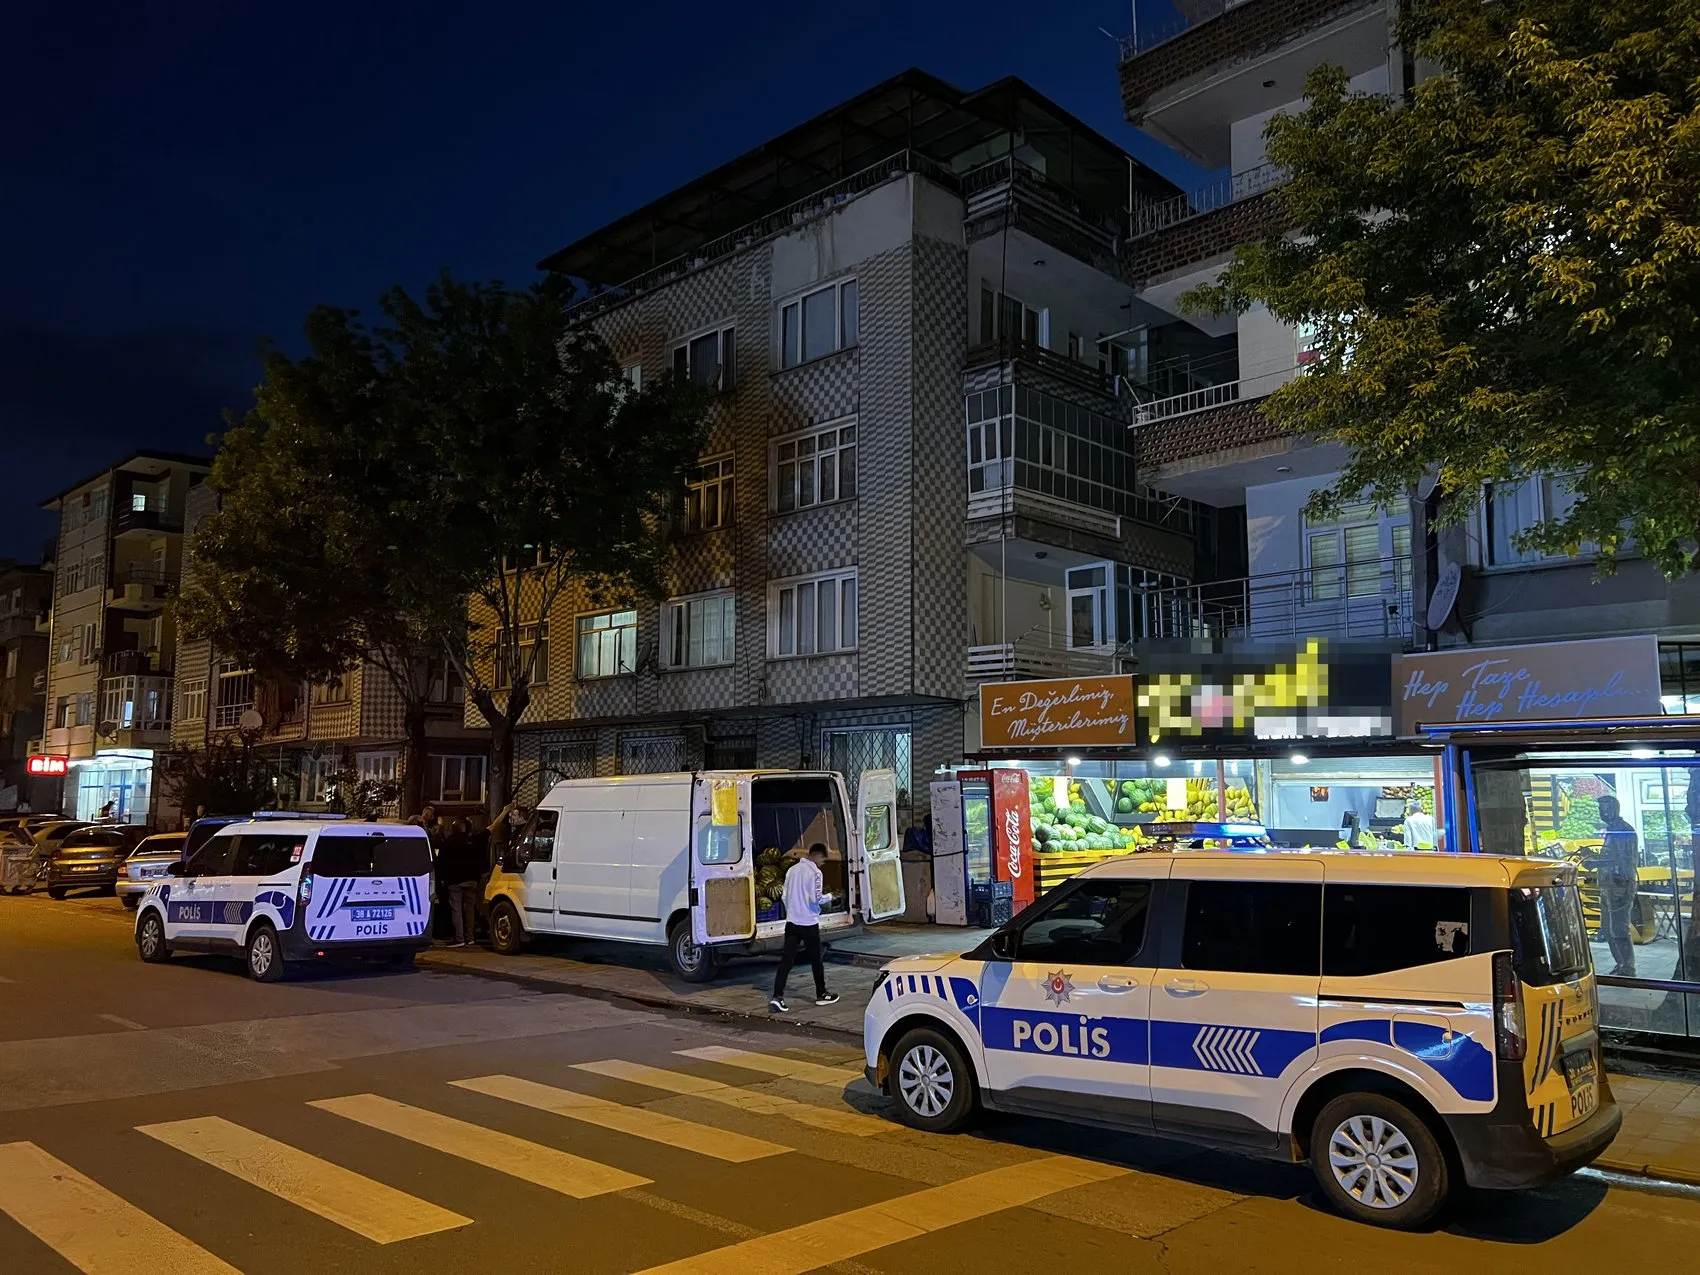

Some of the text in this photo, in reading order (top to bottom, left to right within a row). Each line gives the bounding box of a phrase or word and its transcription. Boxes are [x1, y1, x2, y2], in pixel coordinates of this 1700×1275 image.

[1404, 659, 1530, 707] Hep Taze
[991, 684, 1114, 722] En Değerlimiz,
[1456, 691, 1504, 720] Hep
[1007, 708, 1129, 741] Müşterilerimiz
[31, 757, 64, 772] BİM
[178, 904, 201, 920] POLİS
[356, 922, 388, 935] POLİS
[1013, 1015, 1110, 1058] POLİS
